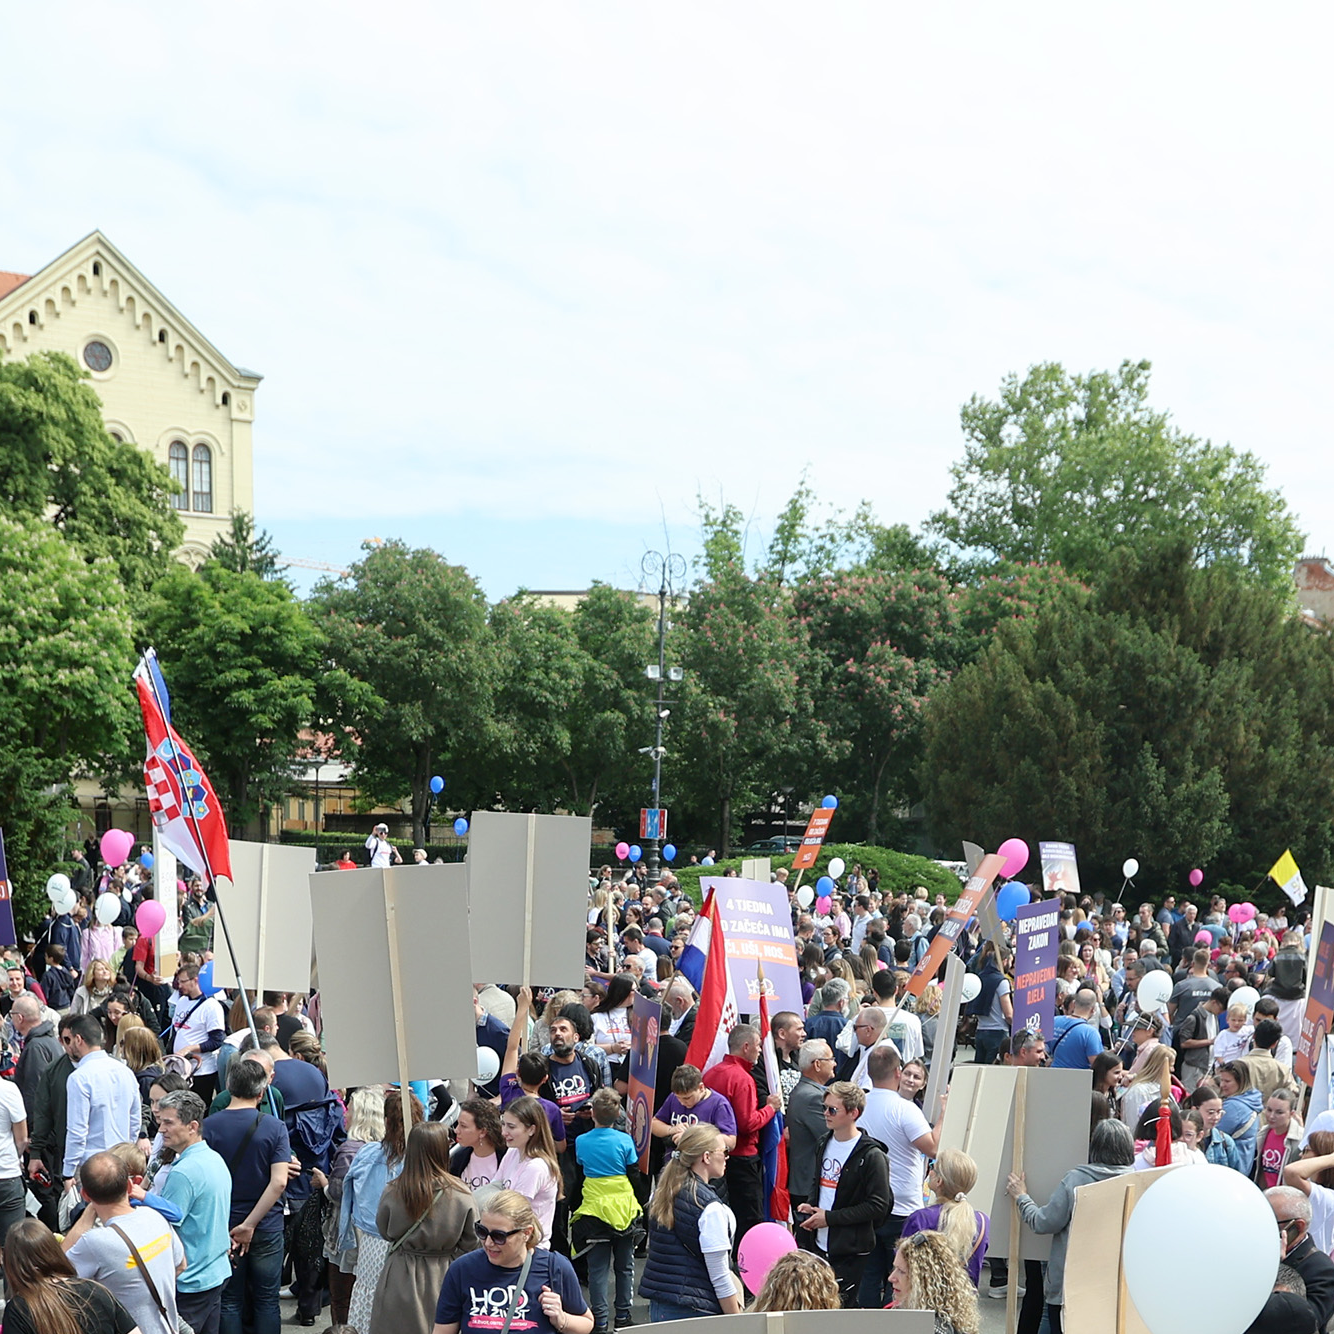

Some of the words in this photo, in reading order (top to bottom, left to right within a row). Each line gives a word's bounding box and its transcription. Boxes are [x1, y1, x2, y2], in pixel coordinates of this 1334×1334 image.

[726, 899, 735, 911] 4
[735, 898, 774, 916] TJEDNA
[729, 918, 771, 936] ZAČEĆA
[771, 924, 791, 940] IMA
[1018, 911, 1059, 936] NEPRAVEDAN
[740, 940, 763, 958] UŠI,
[763, 944, 793, 961] NOS...
[1027, 931, 1049, 952] ZAKON
[1016, 965, 1056, 990] NEPRAVEDNA
[1026, 986, 1045, 1006] DJELA
[552, 1075, 585, 1092] HOD
[469, 1284, 529, 1310] HOD
[469, 1306, 488, 1317] ZA
